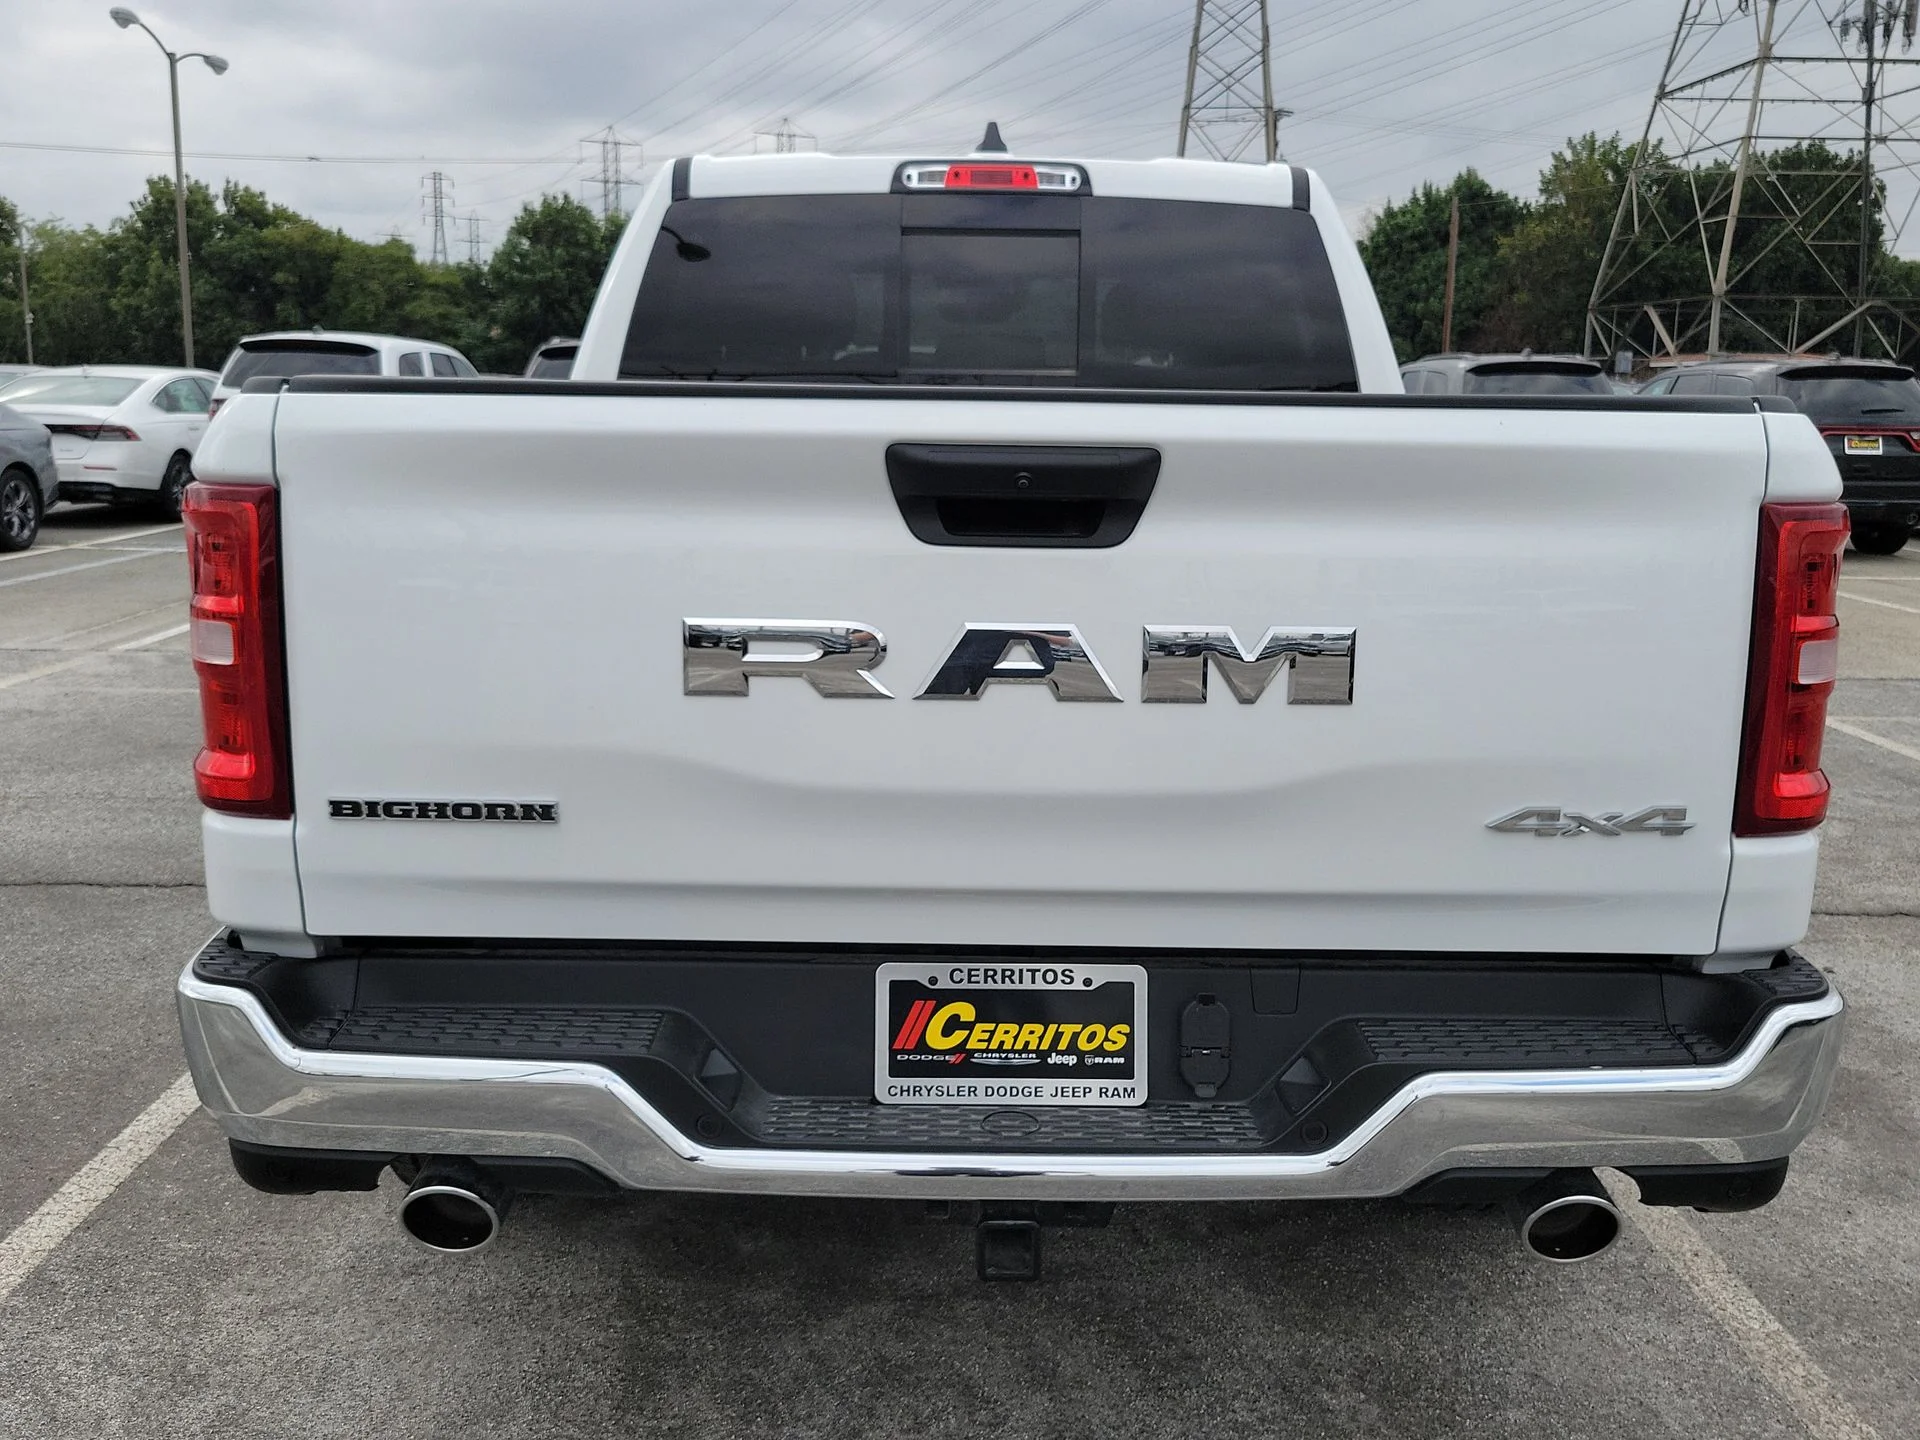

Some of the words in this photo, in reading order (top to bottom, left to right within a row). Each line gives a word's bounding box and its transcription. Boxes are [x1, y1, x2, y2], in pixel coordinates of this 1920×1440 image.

[682, 617, 1356, 704] RAM
[328, 799, 557, 823] BIGHORN
[949, 968, 1075, 985] CERRITOS
[925, 1001, 1131, 1051] CERRITOS
[897, 1054, 956, 1062] DODGE
[1047, 1052, 1077, 1067] Jeep
[887, 1085, 978, 1098] CHRYSLER
[984, 1086, 1044, 1098] DODGE
[1050, 1086, 1093, 1099] JEEP
[1098, 1087, 1137, 1099] RAM
